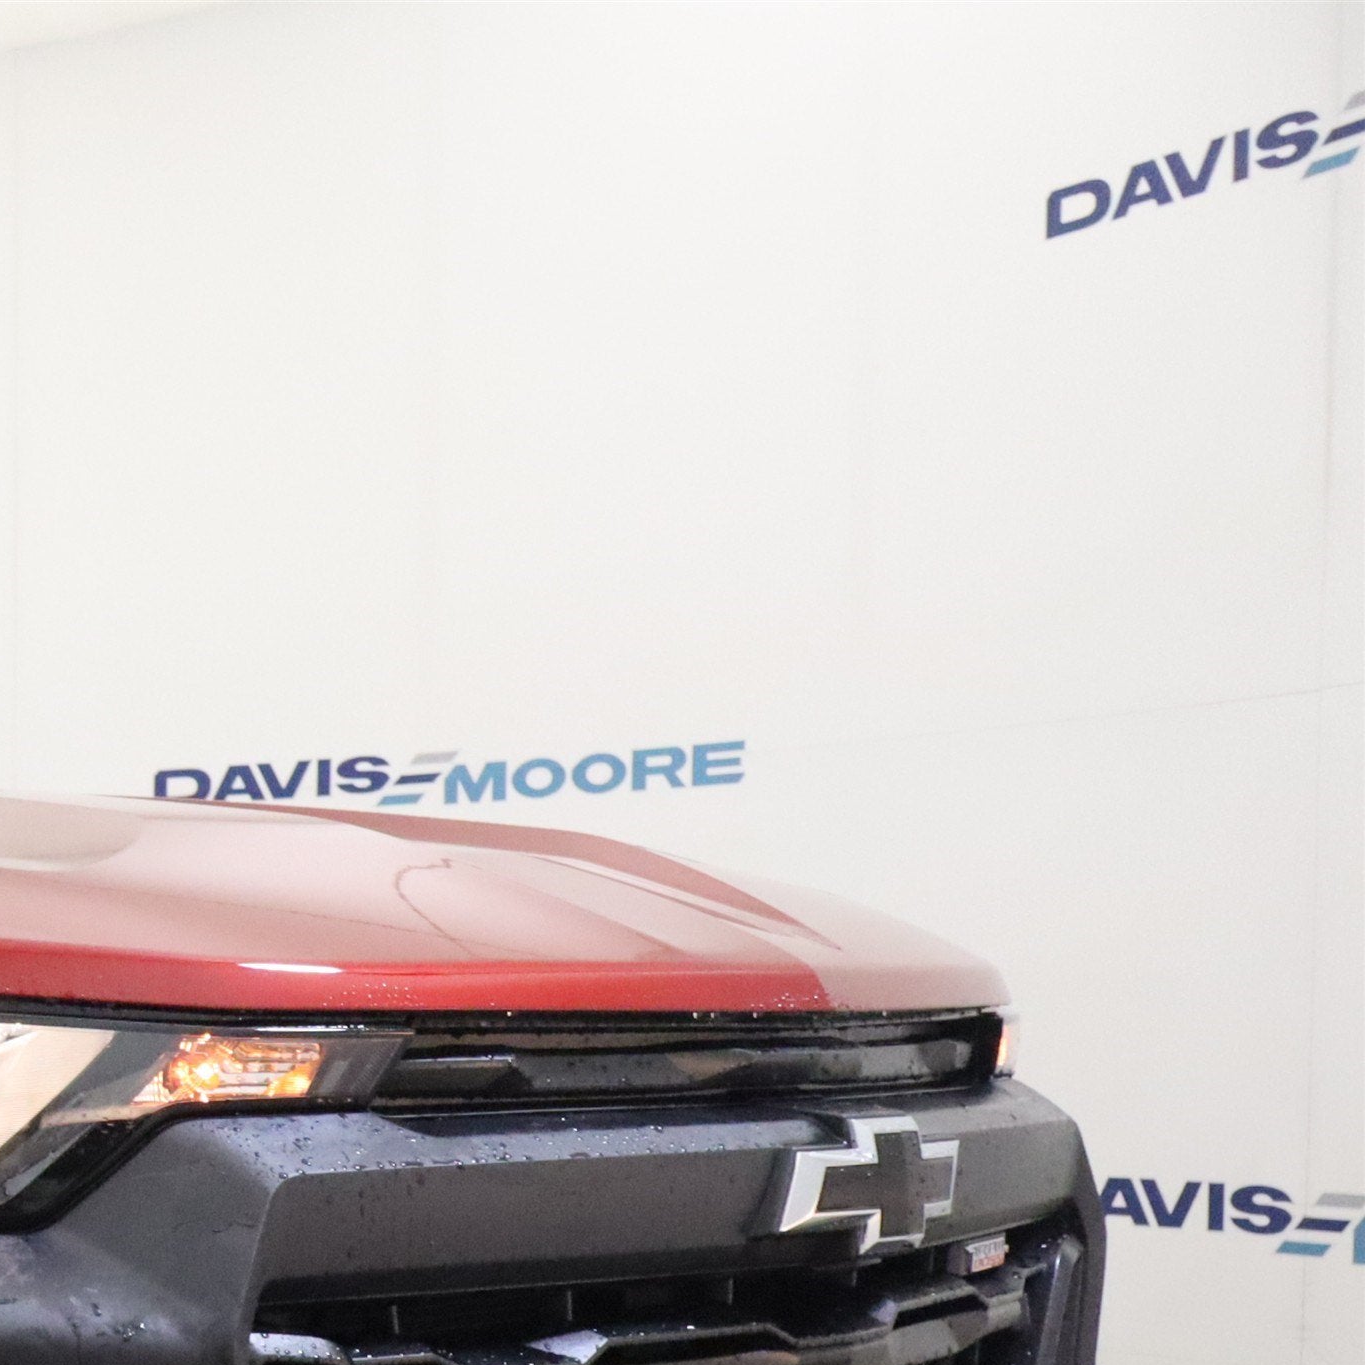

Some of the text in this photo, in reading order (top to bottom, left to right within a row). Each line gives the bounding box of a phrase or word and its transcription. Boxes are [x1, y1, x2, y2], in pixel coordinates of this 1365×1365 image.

[1046, 110, 1320, 240] DAVIS
[154, 740, 745, 804] DAVIS MOORE
[1099, 1177, 1293, 1235] AVIS
